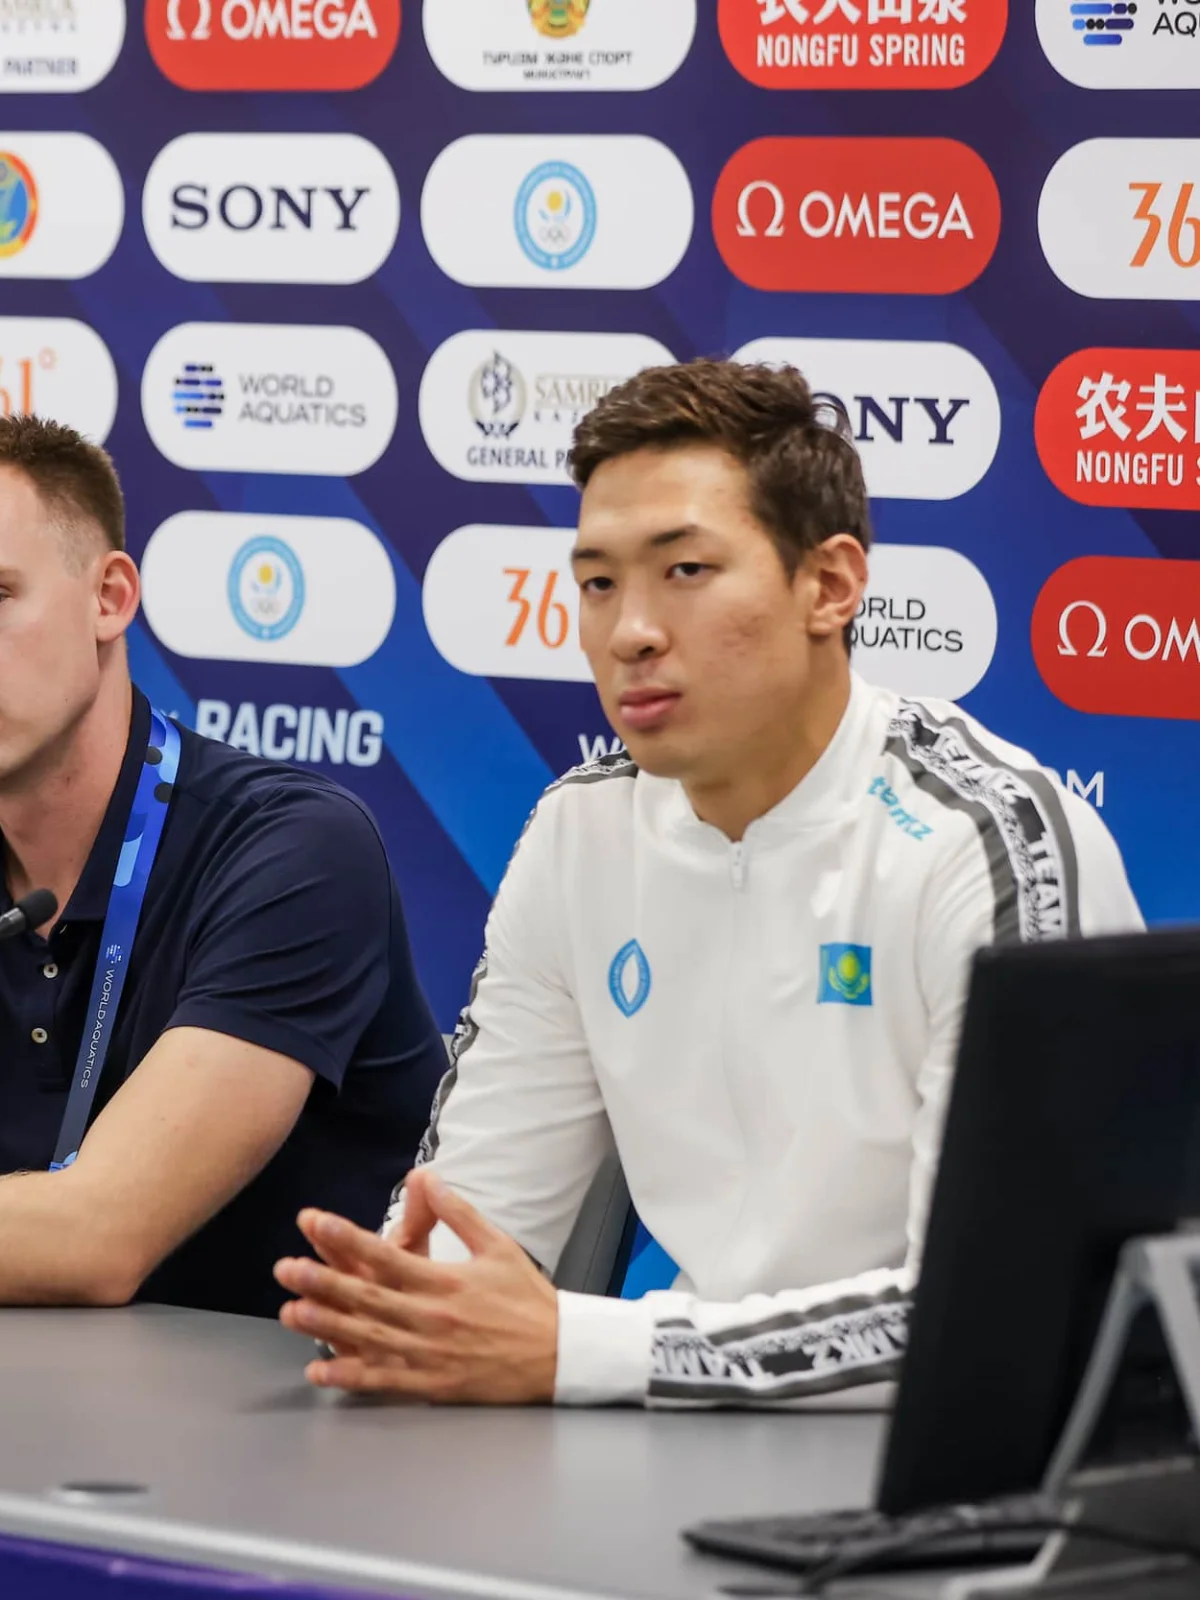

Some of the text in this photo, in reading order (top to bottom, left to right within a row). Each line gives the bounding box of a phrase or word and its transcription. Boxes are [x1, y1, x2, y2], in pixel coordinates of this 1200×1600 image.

[221, 0, 378, 39] OMEGA
[1152, 11, 1200, 38] AQ
[757, 34, 965, 67] NONGFU SPRING
[4, 58, 79, 77] PARTNER
[170, 184, 370, 232] SONY
[799, 190, 975, 239] OMEGA
[239, 374, 334, 399] WORLD
[237, 400, 368, 428] AQUATICS
[1076, 370, 1200, 444] 农夫
[467, 446, 549, 469] GENERAL
[1076, 450, 1184, 487] NONGFU
[854, 596, 926, 621] RLD
[850, 625, 964, 653] UATICS
[195, 699, 384, 768] RACING
[81, 969, 116, 1089] WORLD AQUATICS
